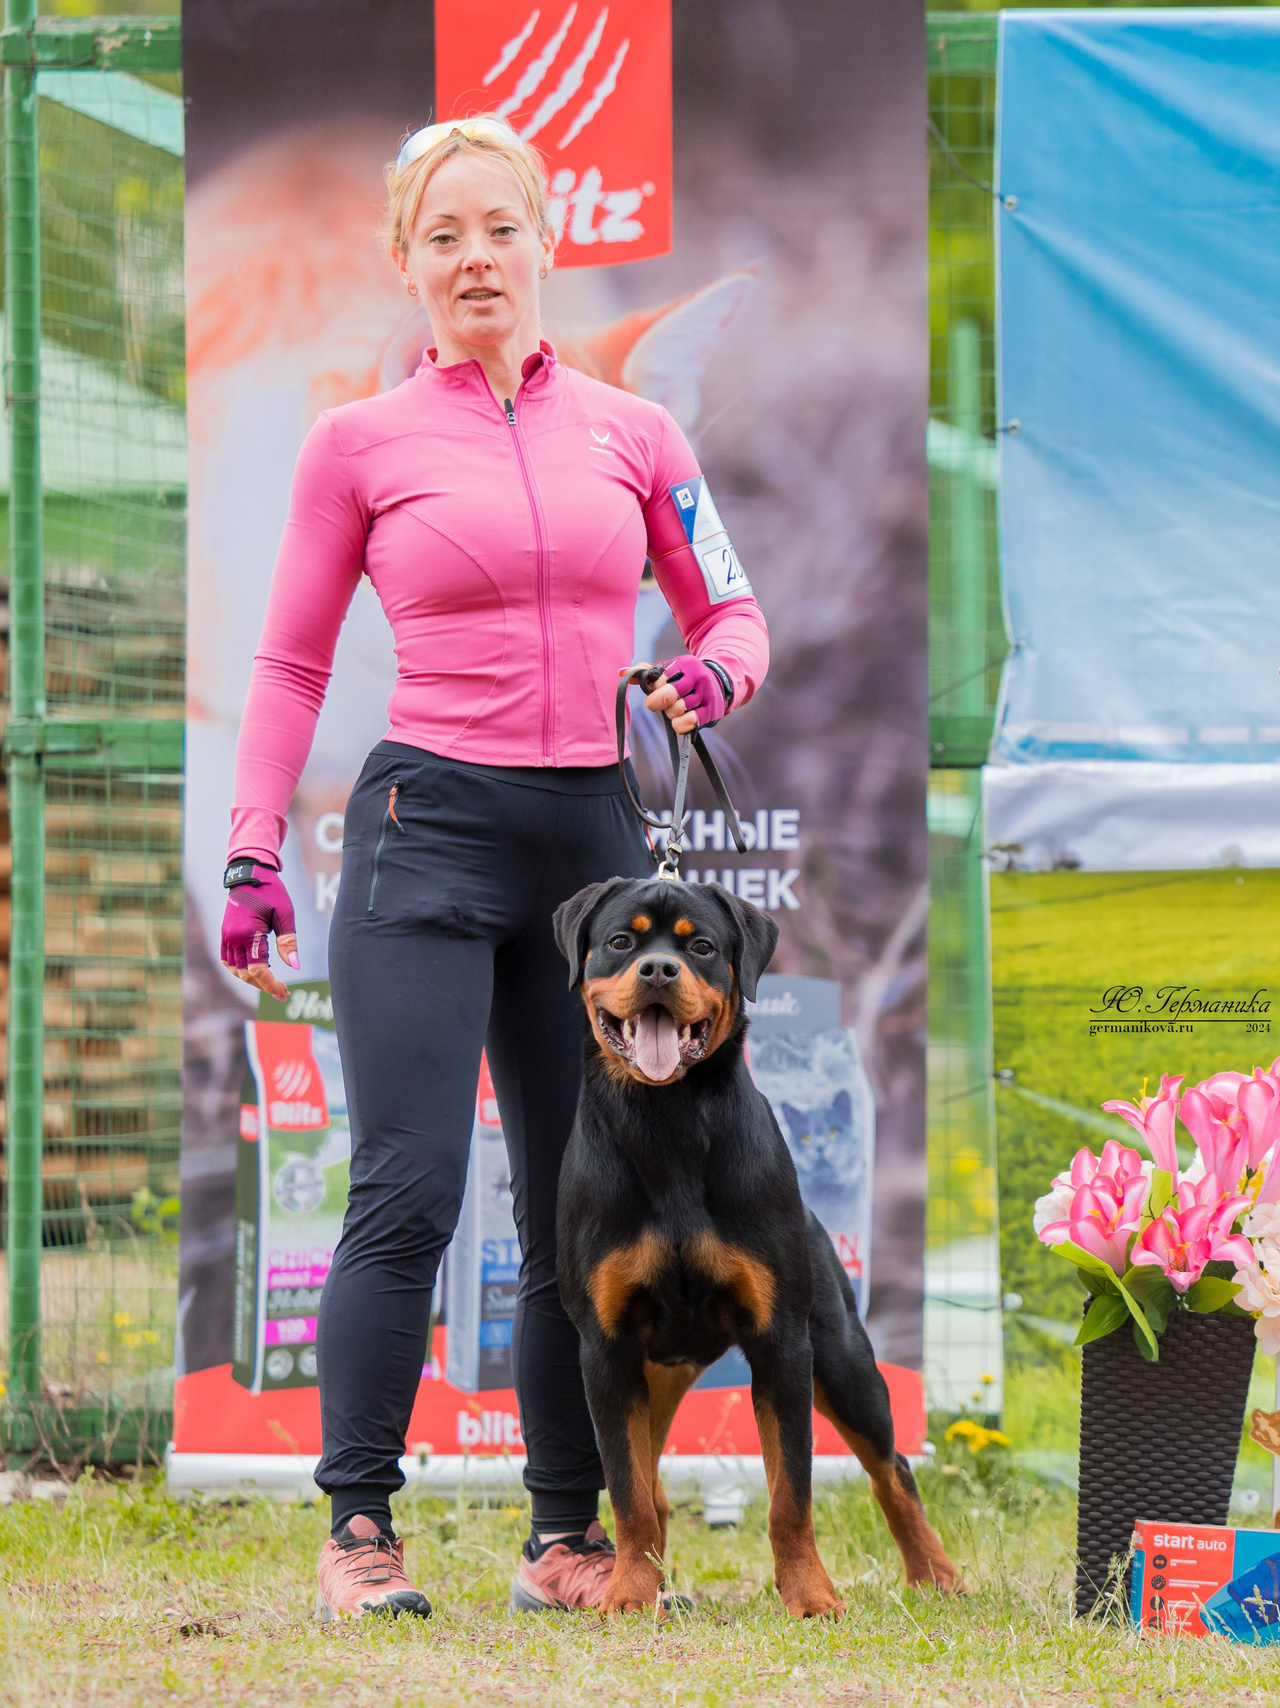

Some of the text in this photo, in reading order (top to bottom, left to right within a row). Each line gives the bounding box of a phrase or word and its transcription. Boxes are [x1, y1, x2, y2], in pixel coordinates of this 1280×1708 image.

[549, 166, 645, 248] itz
[1153, 1533, 1195, 1549] start
[1196, 1539, 1227, 1551] auto
